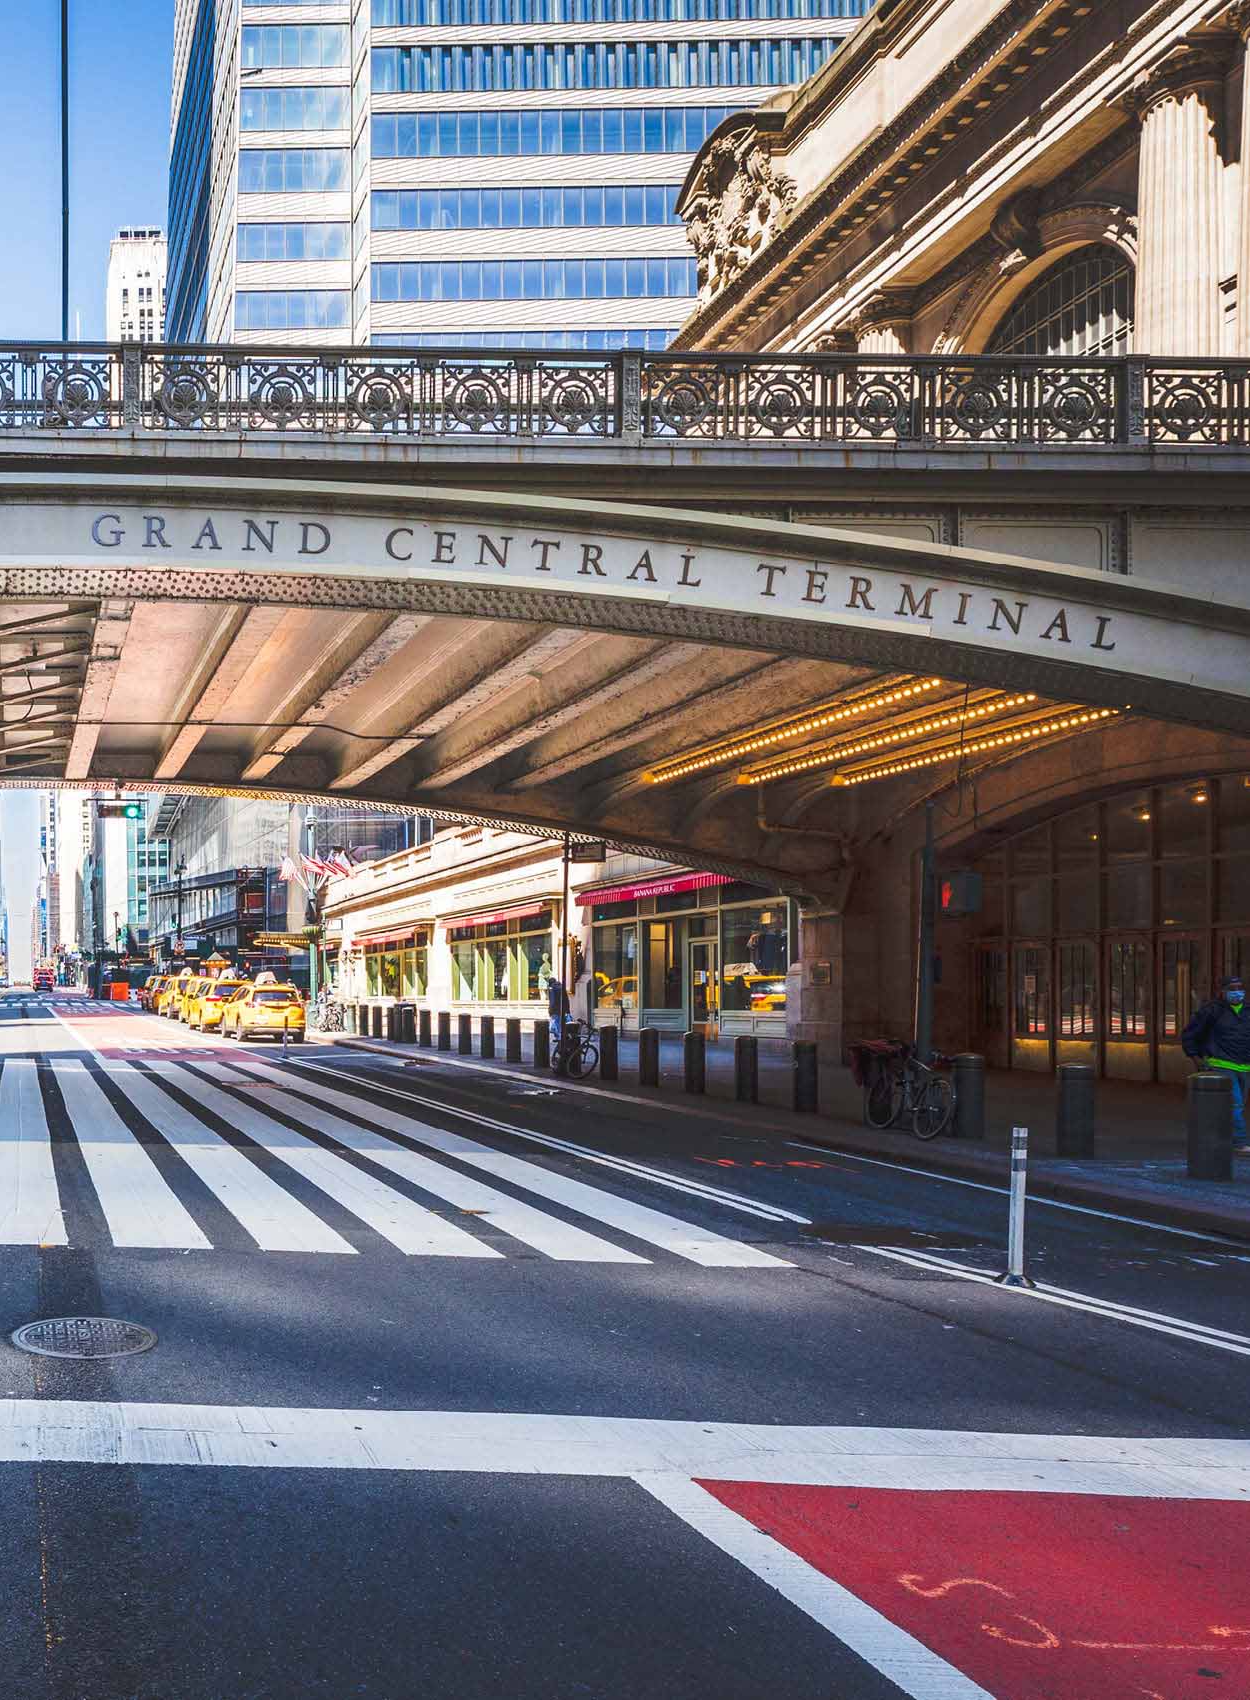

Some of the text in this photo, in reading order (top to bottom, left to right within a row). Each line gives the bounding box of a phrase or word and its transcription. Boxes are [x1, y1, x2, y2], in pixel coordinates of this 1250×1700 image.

[91, 513, 1117, 651] GRAND CENTRAL TERMINAL
[633, 884, 676, 898] BANANA REPUBLIC
